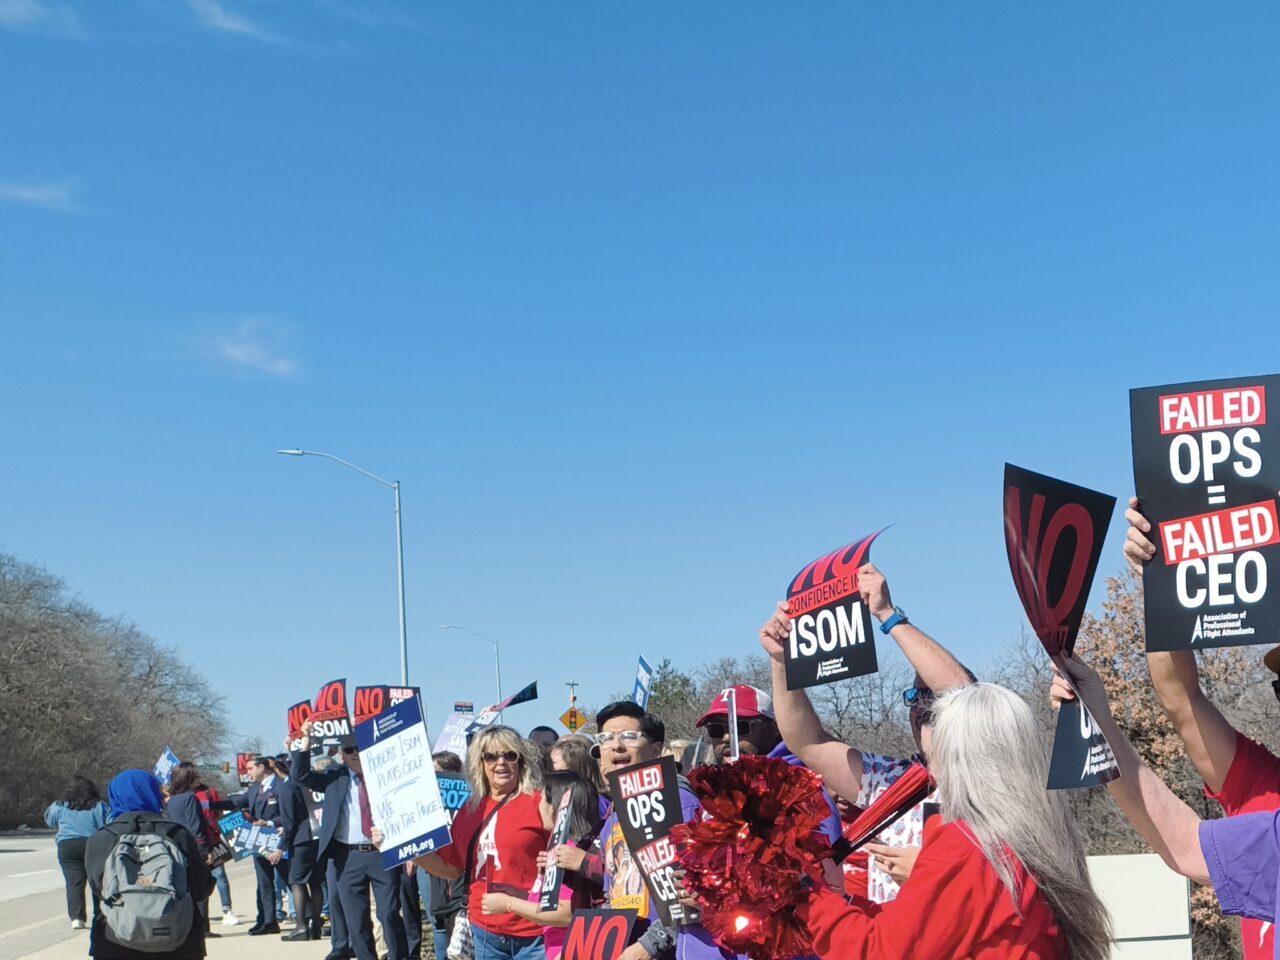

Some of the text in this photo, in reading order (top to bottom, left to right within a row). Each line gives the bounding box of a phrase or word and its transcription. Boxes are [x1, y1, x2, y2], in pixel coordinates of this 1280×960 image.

[1162, 390, 1261, 431] FAILED
[1169, 427, 1262, 484] OPS
[1163, 506, 1274, 561] FAILED
[1006, 486, 1094, 627] NO
[788, 576, 849, 614] CONFIDENCE
[1176, 550, 1267, 608] CEO
[790, 601, 866, 659] ISOM
[315, 682, 345, 712] NO
[355, 687, 384, 715] NO
[289, 703, 312, 733] NO
[366, 745, 396, 775] ROBERT
[377, 754, 424, 789] PLAYS GOLF
[619, 766, 661, 798] FAILED
[377, 797, 395, 820] WE
[384, 820, 400, 840] PAY
[400, 812, 416, 830] THE
[626, 791, 666, 829] OPS
[398, 838, 434, 860] APFA.org
